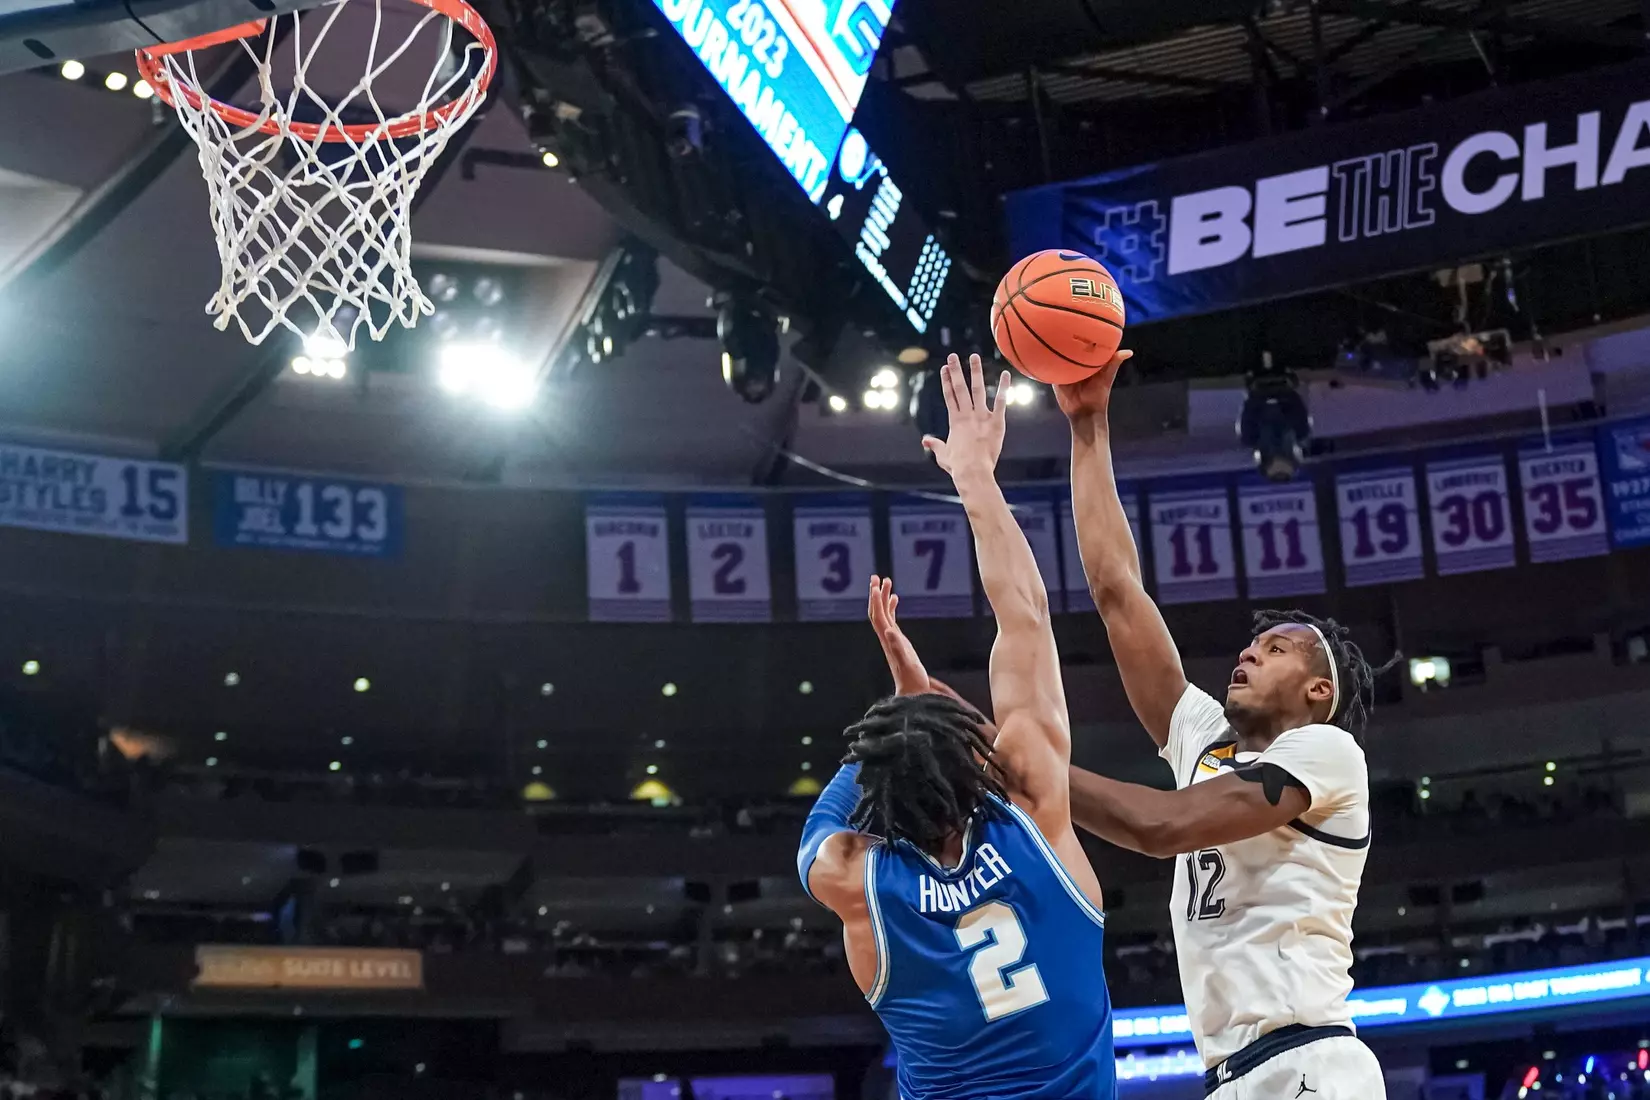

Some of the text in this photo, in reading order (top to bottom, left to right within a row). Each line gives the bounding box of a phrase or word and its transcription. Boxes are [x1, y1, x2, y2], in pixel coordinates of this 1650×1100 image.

[725, 0, 788, 78] 2023
[1332, 142, 1439, 242] THE
[120, 465, 179, 520] 15
[294, 484, 387, 541] 133
[1432, 490, 1506, 547] 30
[1527, 476, 1598, 535] 35
[1169, 523, 1219, 577] 11
[1258, 517, 1307, 571] 11
[1350, 502, 1410, 558] 19
[615, 541, 642, 594] 1
[711, 543, 746, 594] 2
[818, 542, 853, 593] 3
[914, 538, 946, 590] 7
[920, 842, 1013, 913] HUNTER
[1186, 848, 1228, 921] 12
[953, 899, 1050, 1023] 2
